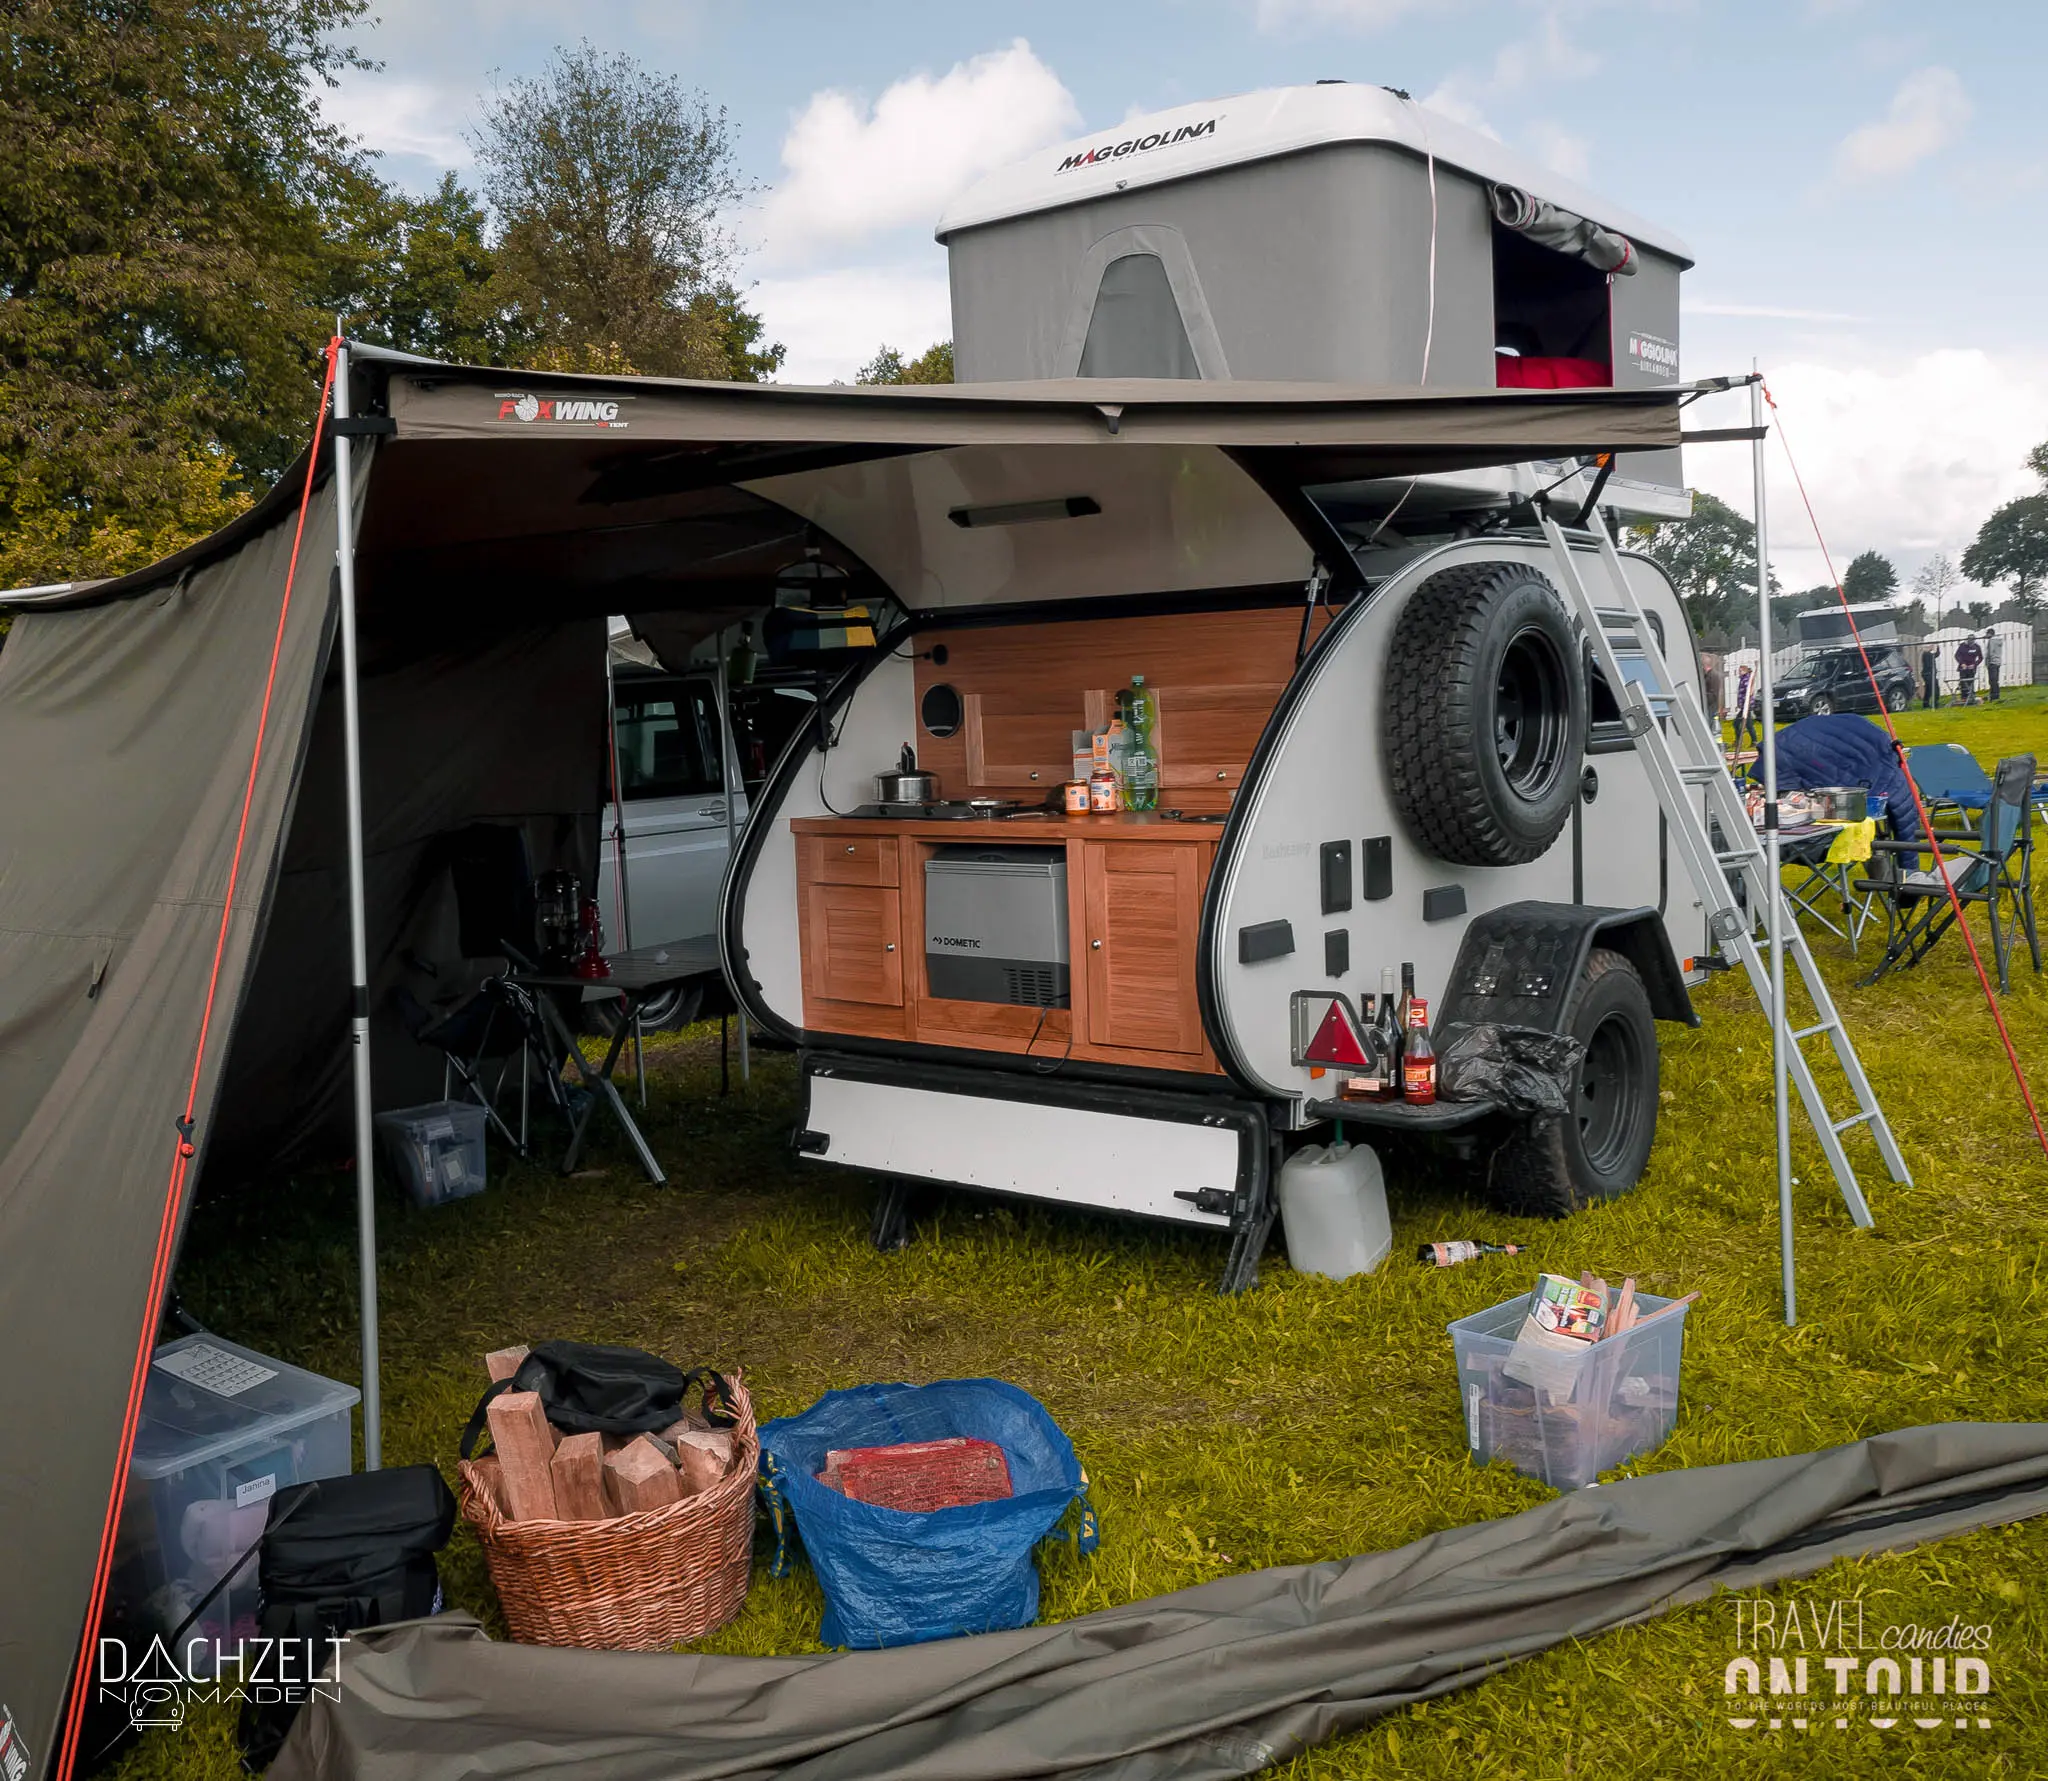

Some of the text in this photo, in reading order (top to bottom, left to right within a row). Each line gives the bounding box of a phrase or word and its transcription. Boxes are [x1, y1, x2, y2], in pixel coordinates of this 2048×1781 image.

[1057, 119, 1216, 172] MAGGIOLINA
[944, 937, 981, 949] DOMETIC
[242, 1479, 271, 1494] Janina
